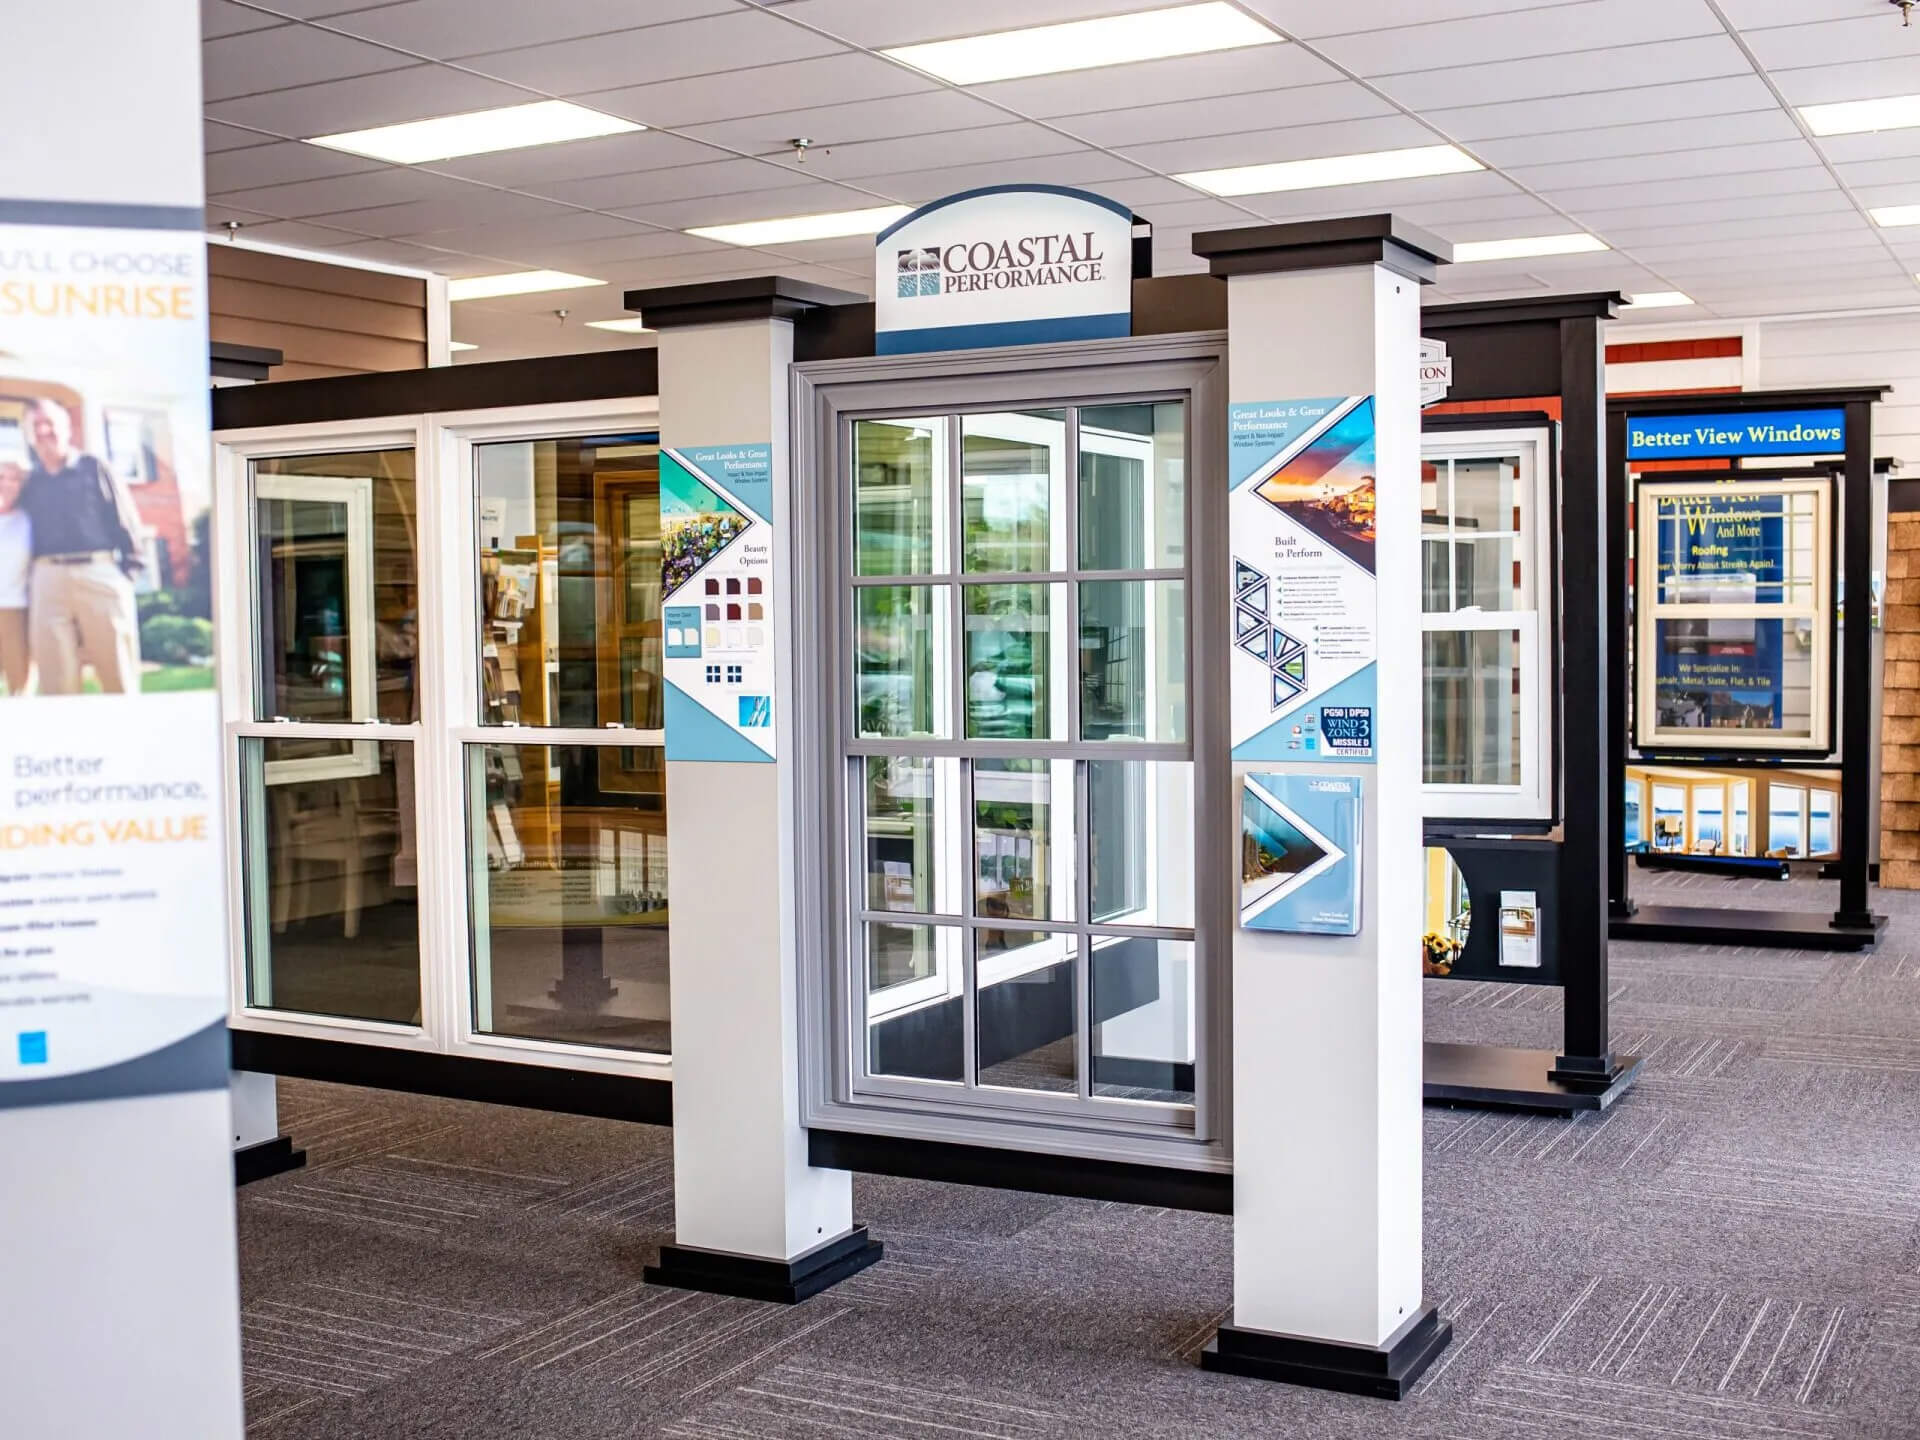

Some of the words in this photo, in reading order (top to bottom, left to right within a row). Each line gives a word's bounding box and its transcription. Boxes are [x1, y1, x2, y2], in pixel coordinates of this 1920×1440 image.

[943, 231, 1104, 274] COASTAL
[69, 251, 193, 277] CHOOSE
[944, 262, 1102, 294] PERFORMANCE
[0, 280, 195, 320] SUNRISE
[1232, 410, 1257, 419] Great
[1260, 408, 1286, 418] Looks
[1288, 407, 1298, 417] &
[1300, 406, 1325, 416] Great
[1233, 421, 1289, 431] Performance
[1632, 431, 1692, 447] Better
[1694, 428, 1744, 445] View
[1747, 424, 1841, 443] Windows
[716, 451, 737, 461] Looks
[724, 460, 768, 470] Performance
[1684, 505, 1761, 536] Windows
[1716, 524, 1735, 538] And
[1737, 523, 1761, 537] More
[1275, 536, 1297, 546] Built
[744, 544, 768, 554] Beauty
[1275, 551, 1284, 559] to
[1287, 548, 1323, 558] Perform
[1691, 545, 1729, 558] Roofing
[739, 555, 769, 567] Options
[1327, 719, 1359, 729] WIND
[1358, 719, 1371, 738] 3
[1327, 728, 1359, 738] ZONE
[1332, 738, 1363, 748] MISSILE
[1336, 748, 1370, 757] CERTIFIED
[14, 755, 105, 779] Better
[101, 814, 209, 844] VALUE
